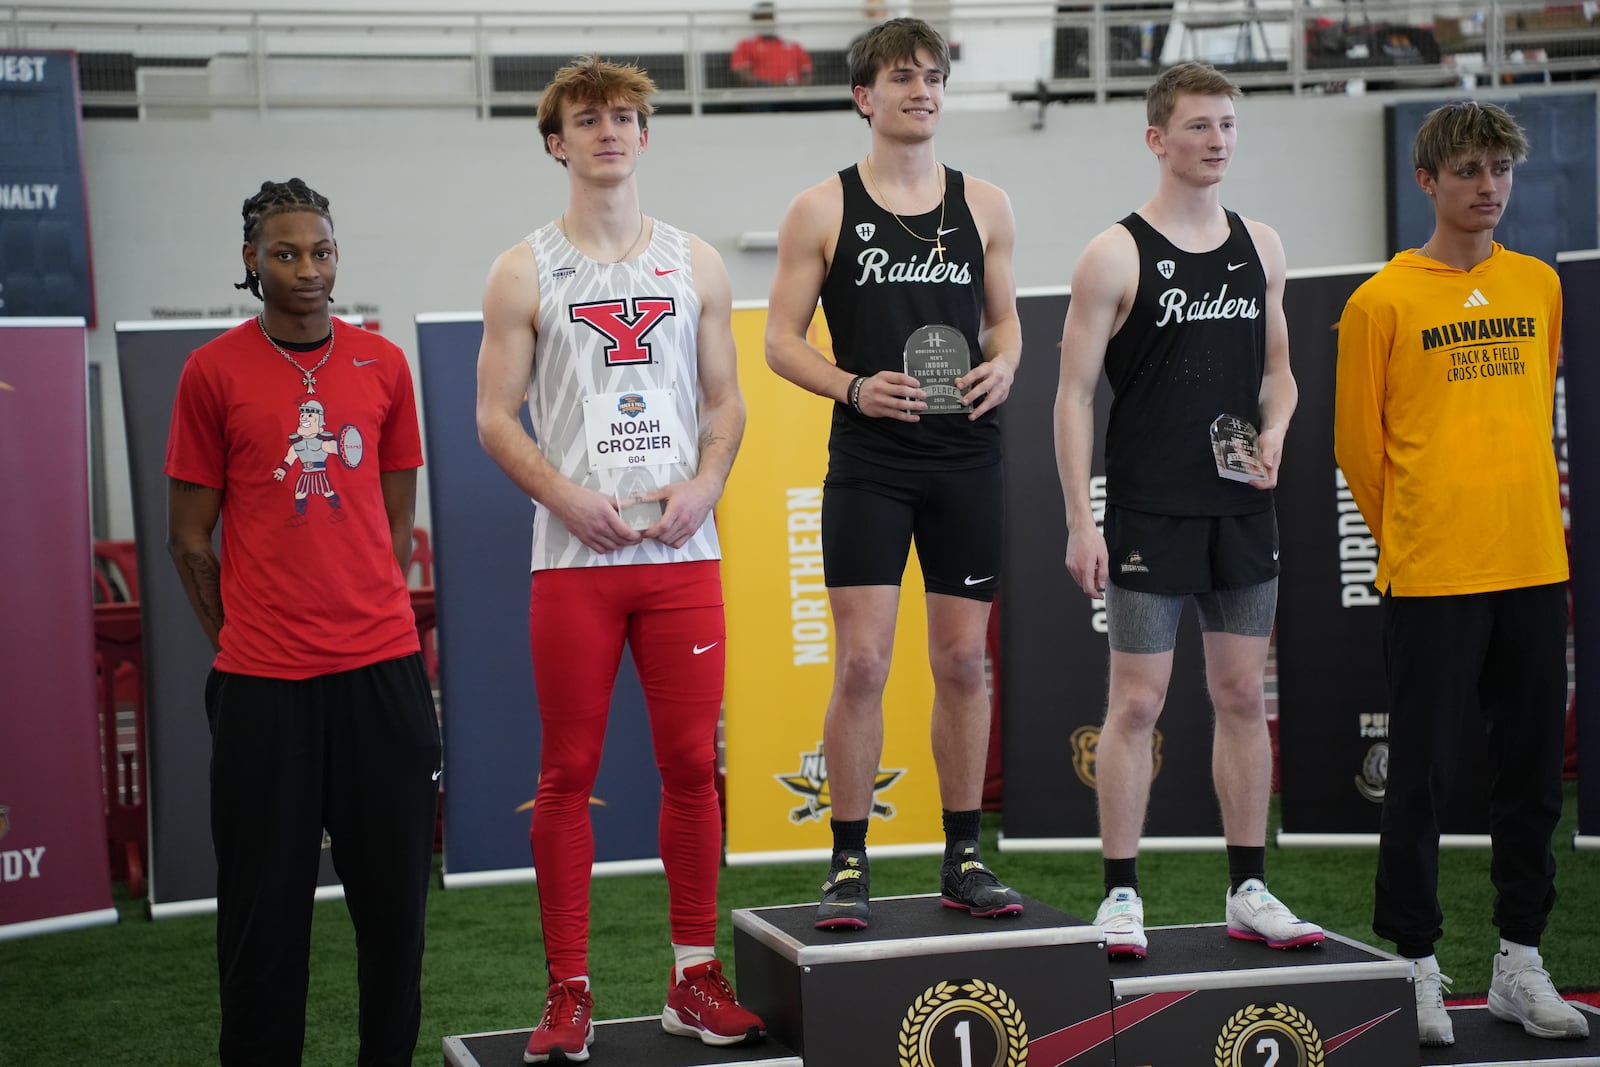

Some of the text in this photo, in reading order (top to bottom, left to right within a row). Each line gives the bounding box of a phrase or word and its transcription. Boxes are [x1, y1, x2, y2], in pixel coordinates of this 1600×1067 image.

[0, 56, 47, 82] EST
[855, 248, 972, 287] Raiders
[1156, 284, 1260, 328] Raiders
[568, 296, 677, 368] Y
[1421, 317, 1536, 351] MILWAUKEE
[1450, 347, 1520, 366] TRACK & FIELD
[1447, 362, 1525, 382] CROSS COUNTRY
[932, 386, 957, 395] PLACE
[611, 419, 660, 436] NOAH
[597, 435, 671, 454] CROZIER
[628, 455, 646, 464] 604
[1336, 467, 1380, 608] PURD
[786, 487, 829, 667] NORTHERN
[0, 846, 46, 882] DY
[835, 869, 862, 882] NIKE
[954, 1020, 972, 1067] 1
[1256, 1038, 1280, 1067] 2
